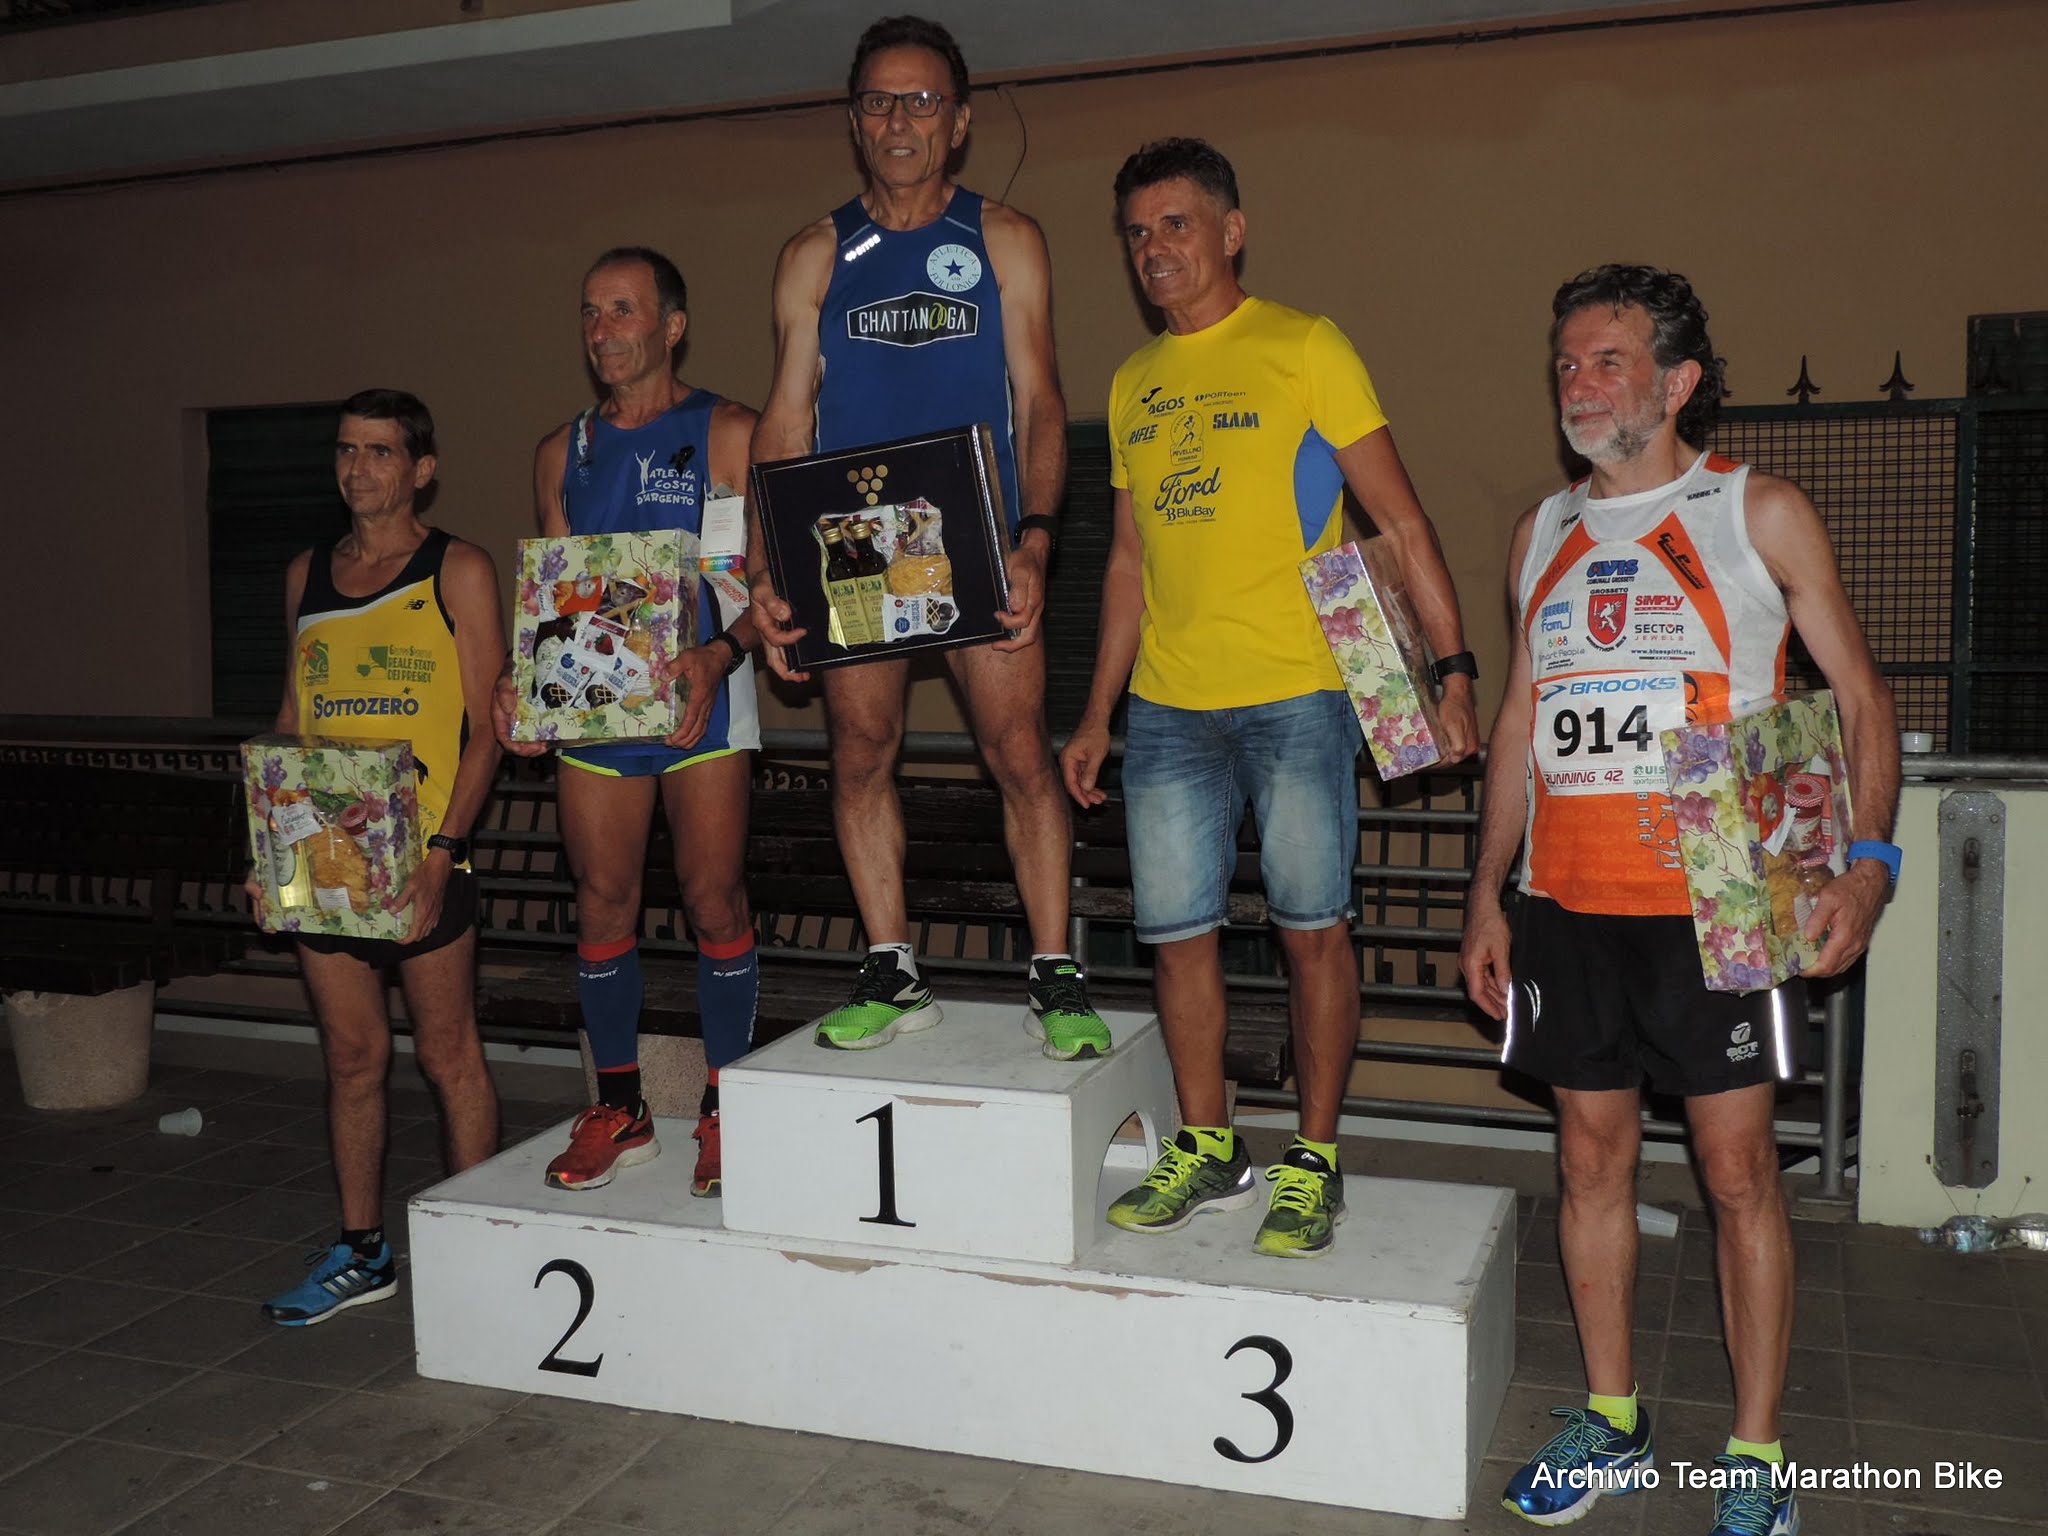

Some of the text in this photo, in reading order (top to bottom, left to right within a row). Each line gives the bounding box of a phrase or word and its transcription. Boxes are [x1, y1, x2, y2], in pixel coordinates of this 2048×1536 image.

[858, 302, 967, 334] CHATTANOOGA
[1147, 396, 1186, 416] AGOS
[1212, 412, 1261, 429] SLAM
[654, 480, 695, 493] COSTA
[1154, 465, 1222, 511] Ford
[636, 492, 695, 506] D'ARGENTO
[1176, 507, 1216, 519] BluBay
[1586, 559, 1639, 578] AVIS
[1589, 587, 1629, 595] GROSSETO
[1634, 623, 1685, 634] SECTOR
[1569, 677, 1677, 696] BROOKS
[1552, 705, 1654, 757] 914
[1645, 765, 1666, 775] UIS
[855, 1101, 918, 1228] 1
[534, 1258, 604, 1378] 2
[1213, 1334, 1294, 1464] 3
